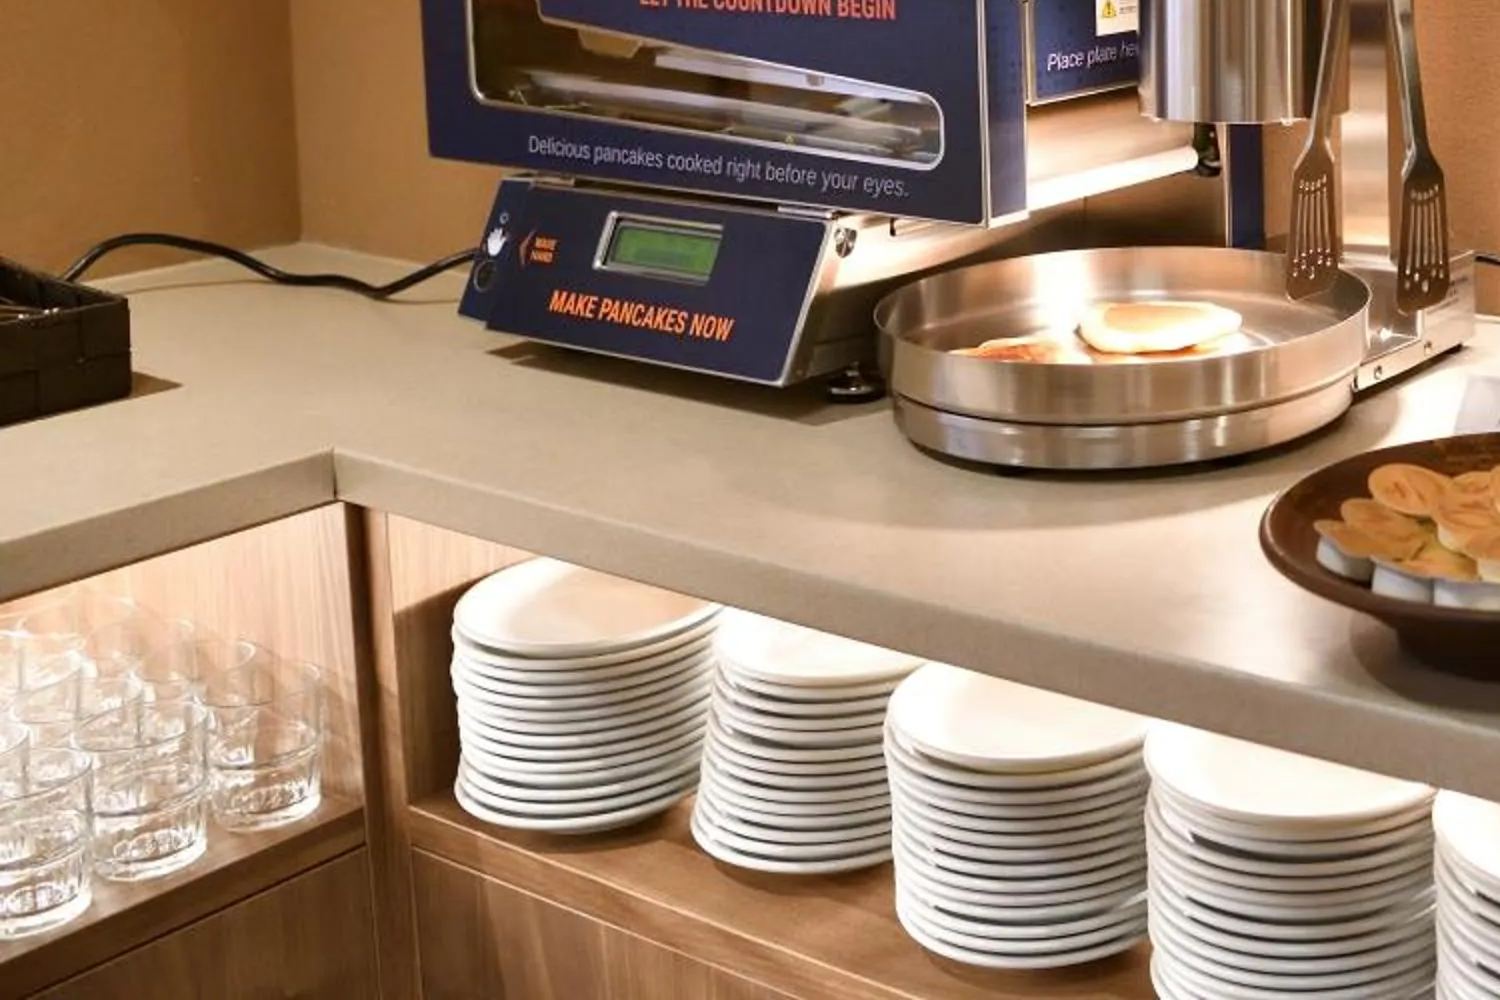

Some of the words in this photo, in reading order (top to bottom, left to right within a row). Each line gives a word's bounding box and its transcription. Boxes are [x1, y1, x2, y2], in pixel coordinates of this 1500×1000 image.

[1047, 52, 1084, 71] Place
[1121, 40, 1140, 58] he
[528, 135, 591, 160] Delicious
[594, 147, 664, 168] pancakes
[667, 154, 722, 176] cooked
[726, 157, 761, 183] right
[765, 161, 816, 187] before
[821, 170, 858, 192] your
[863, 175, 909, 198] eyes.
[550, 290, 598, 318] MAKE
[599, 299, 688, 333] PANCAKES
[690, 313, 735, 341] NOW
